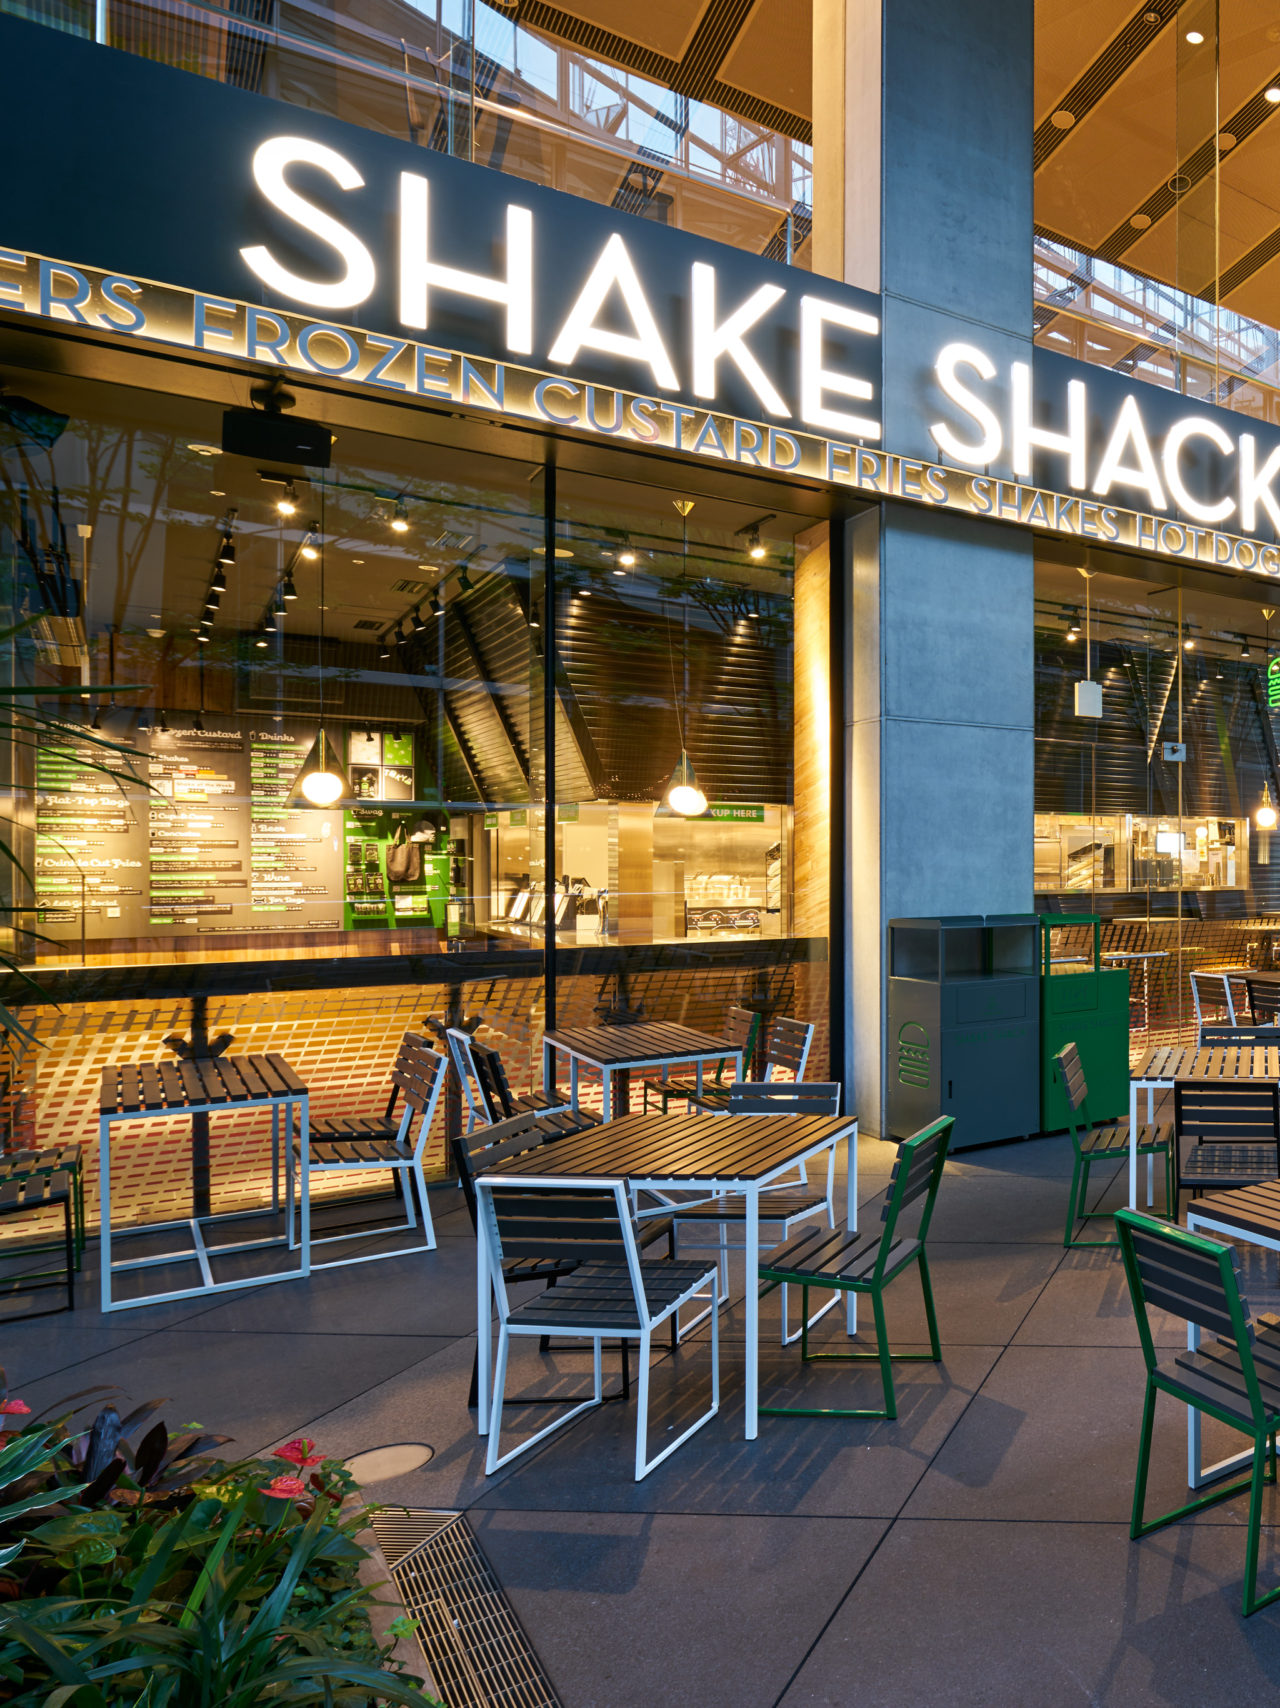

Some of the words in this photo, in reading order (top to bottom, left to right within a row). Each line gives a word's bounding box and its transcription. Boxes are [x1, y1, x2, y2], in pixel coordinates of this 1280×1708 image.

[240, 136, 881, 439] SHAKE
[194, 293, 504, 412] FROZEN
[533, 377, 801, 471] CUSTARD
[825, 441, 949, 504] FRIES
[970, 476, 1119, 541] SHAKES
[259, 732, 295, 742] Drinks
[710, 809, 730, 817] KUP
[733, 810, 758, 818] HERE
